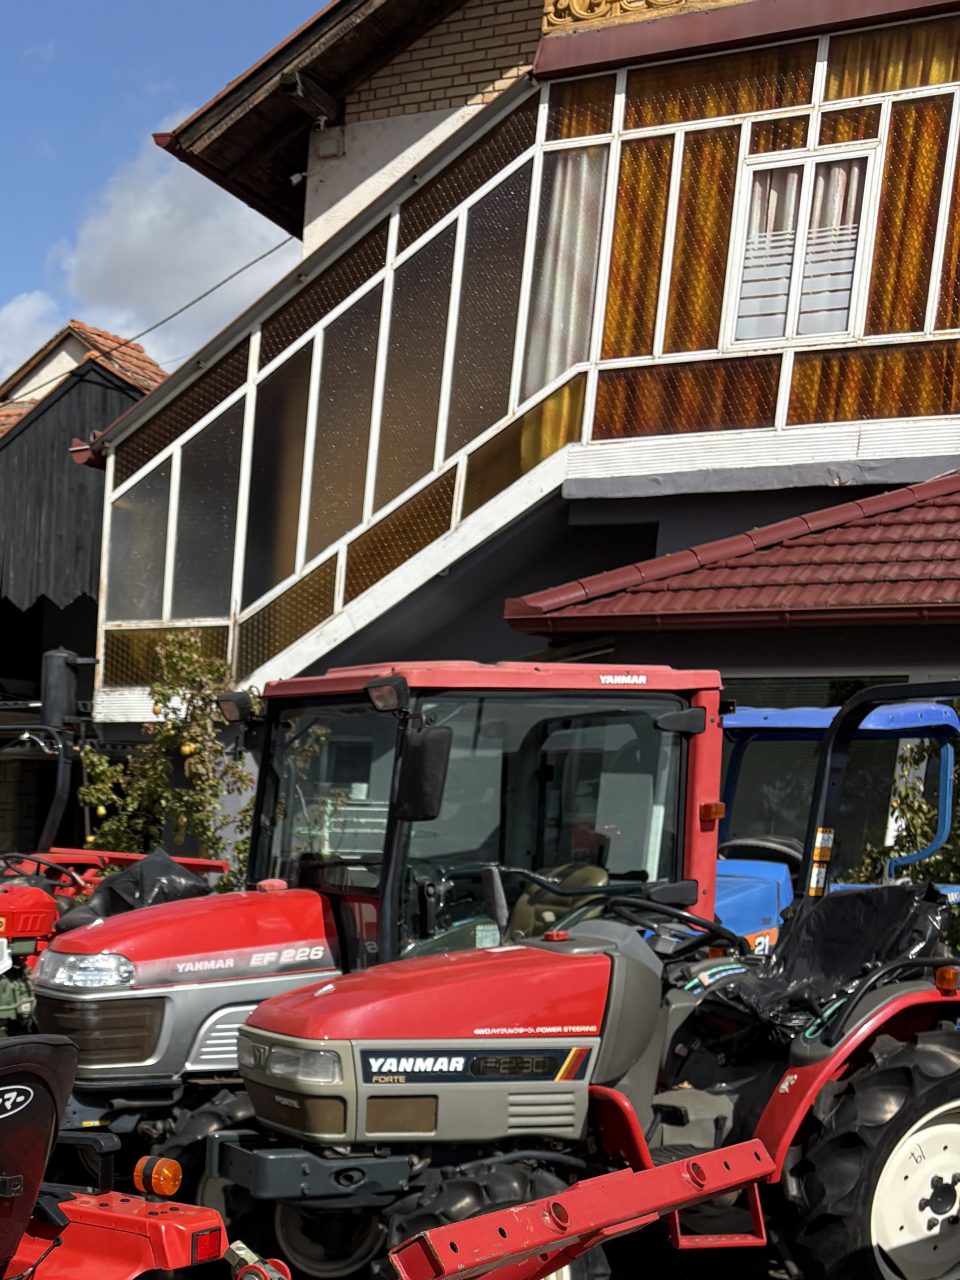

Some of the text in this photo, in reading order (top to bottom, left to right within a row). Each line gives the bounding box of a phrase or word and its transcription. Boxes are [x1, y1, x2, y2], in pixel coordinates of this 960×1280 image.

[599, 675, 647, 685] YANMAR
[176, 958, 235, 973] YANMAR
[368, 1057, 465, 1072] YANMAR
[372, 1075, 406, 1083] FORTE
